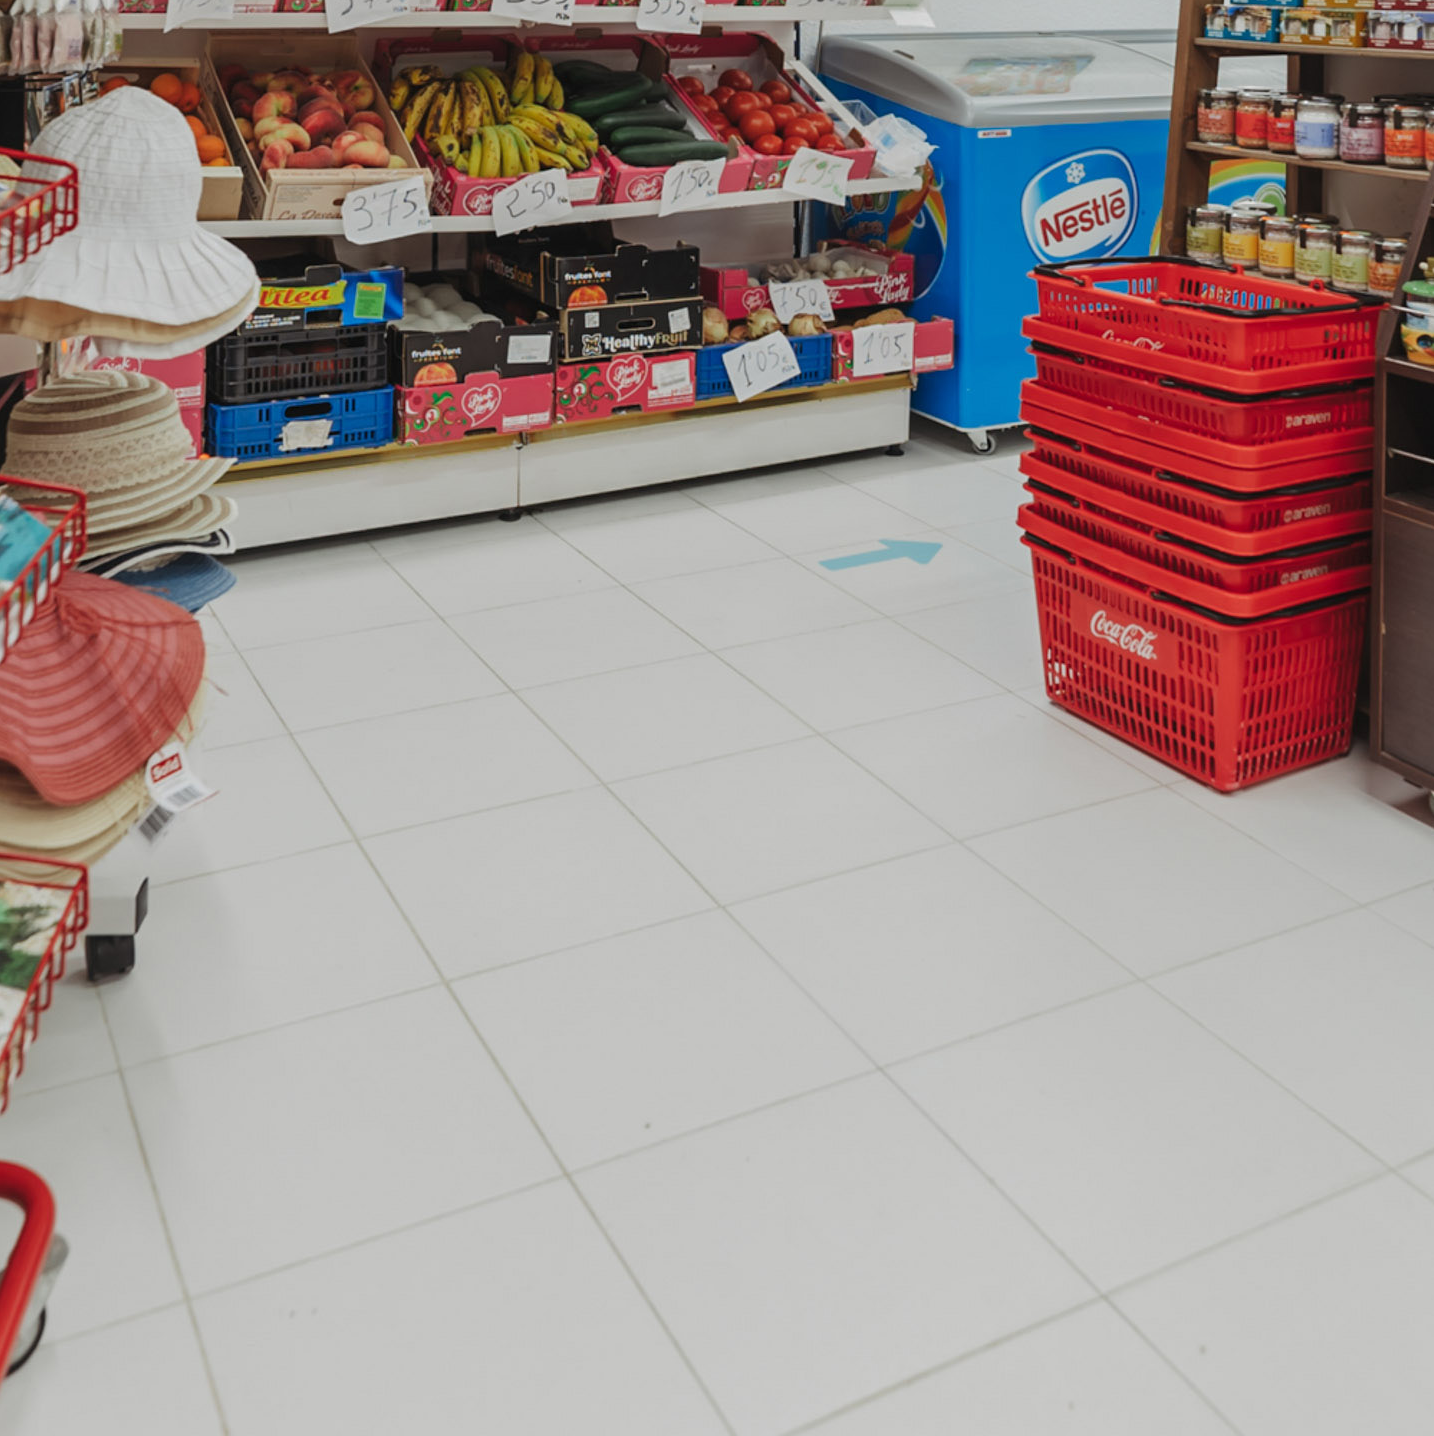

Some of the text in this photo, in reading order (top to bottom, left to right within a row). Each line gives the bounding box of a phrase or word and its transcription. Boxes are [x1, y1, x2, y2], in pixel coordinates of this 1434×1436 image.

[1040, 187, 1126, 250] Nestlé
[874, 272, 909, 294] Pink
[878, 283, 910, 305] Lady
[1090, 610, 1158, 661] Coca-Cola
